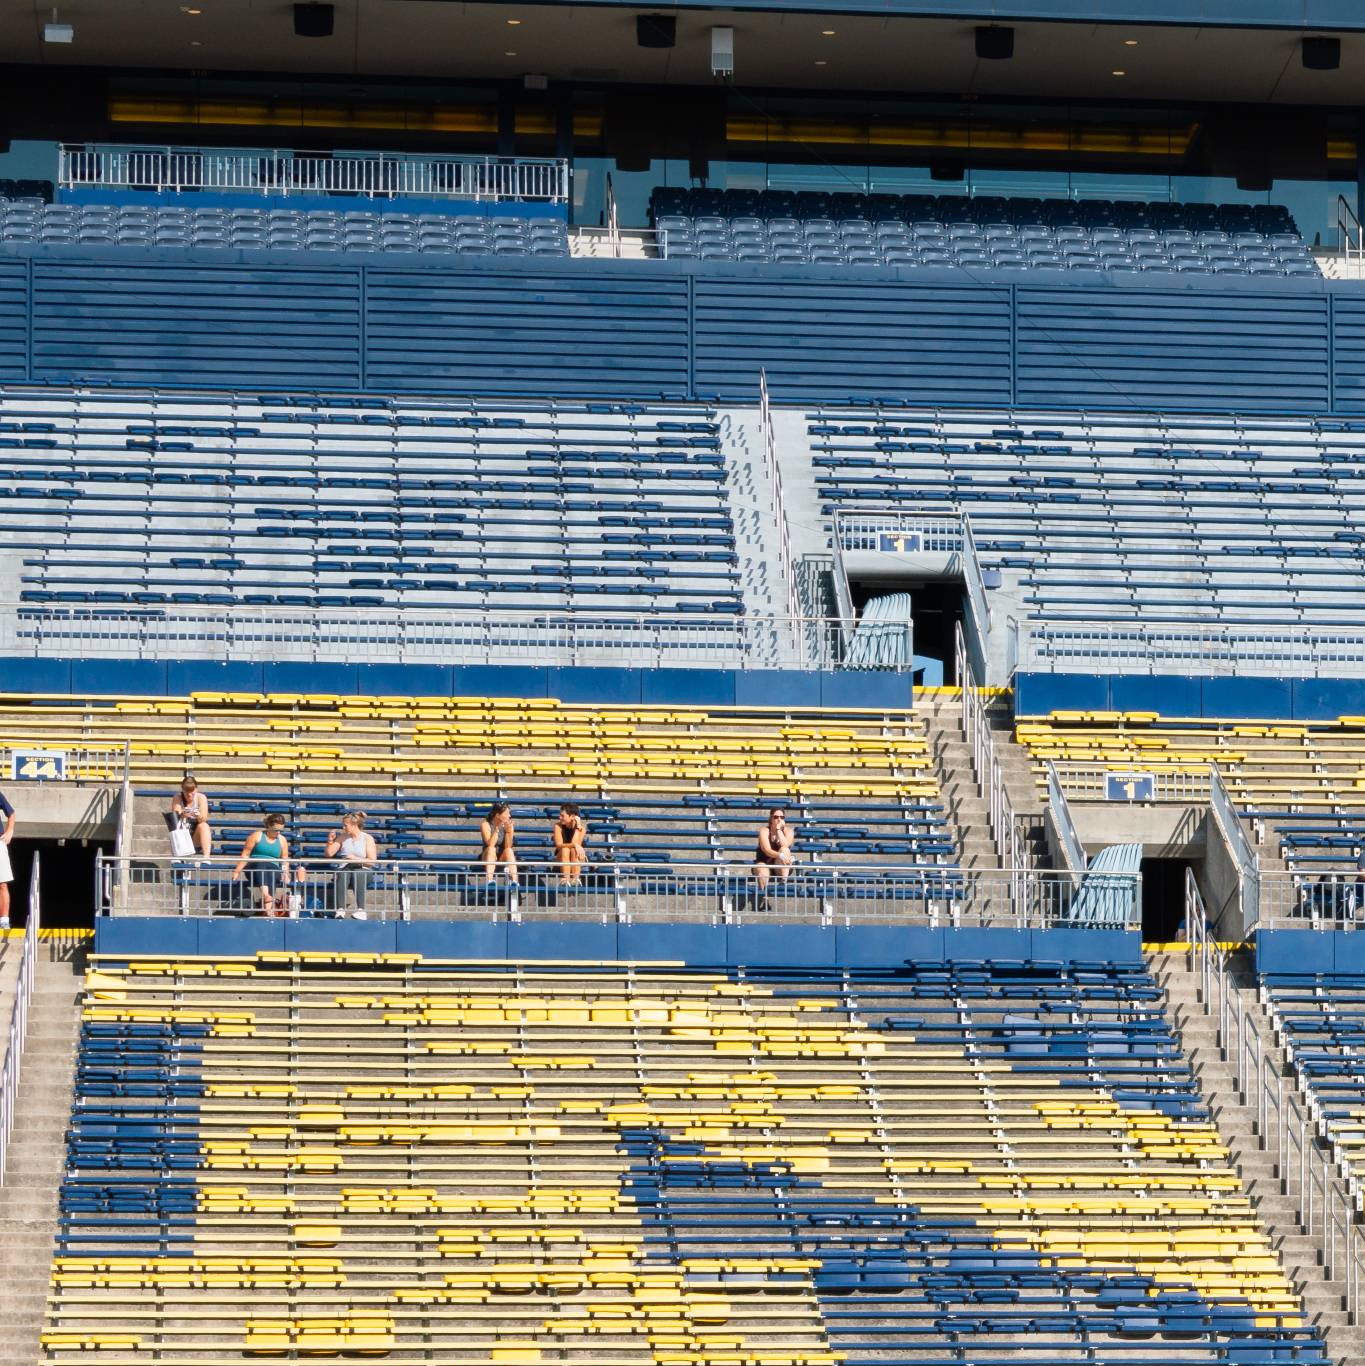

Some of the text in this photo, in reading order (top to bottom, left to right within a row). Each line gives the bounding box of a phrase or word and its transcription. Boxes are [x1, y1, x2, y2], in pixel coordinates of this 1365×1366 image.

[894, 539, 905, 552] 1
[20, 761, 57, 778] 44
[1123, 782, 1136, 799] 1
